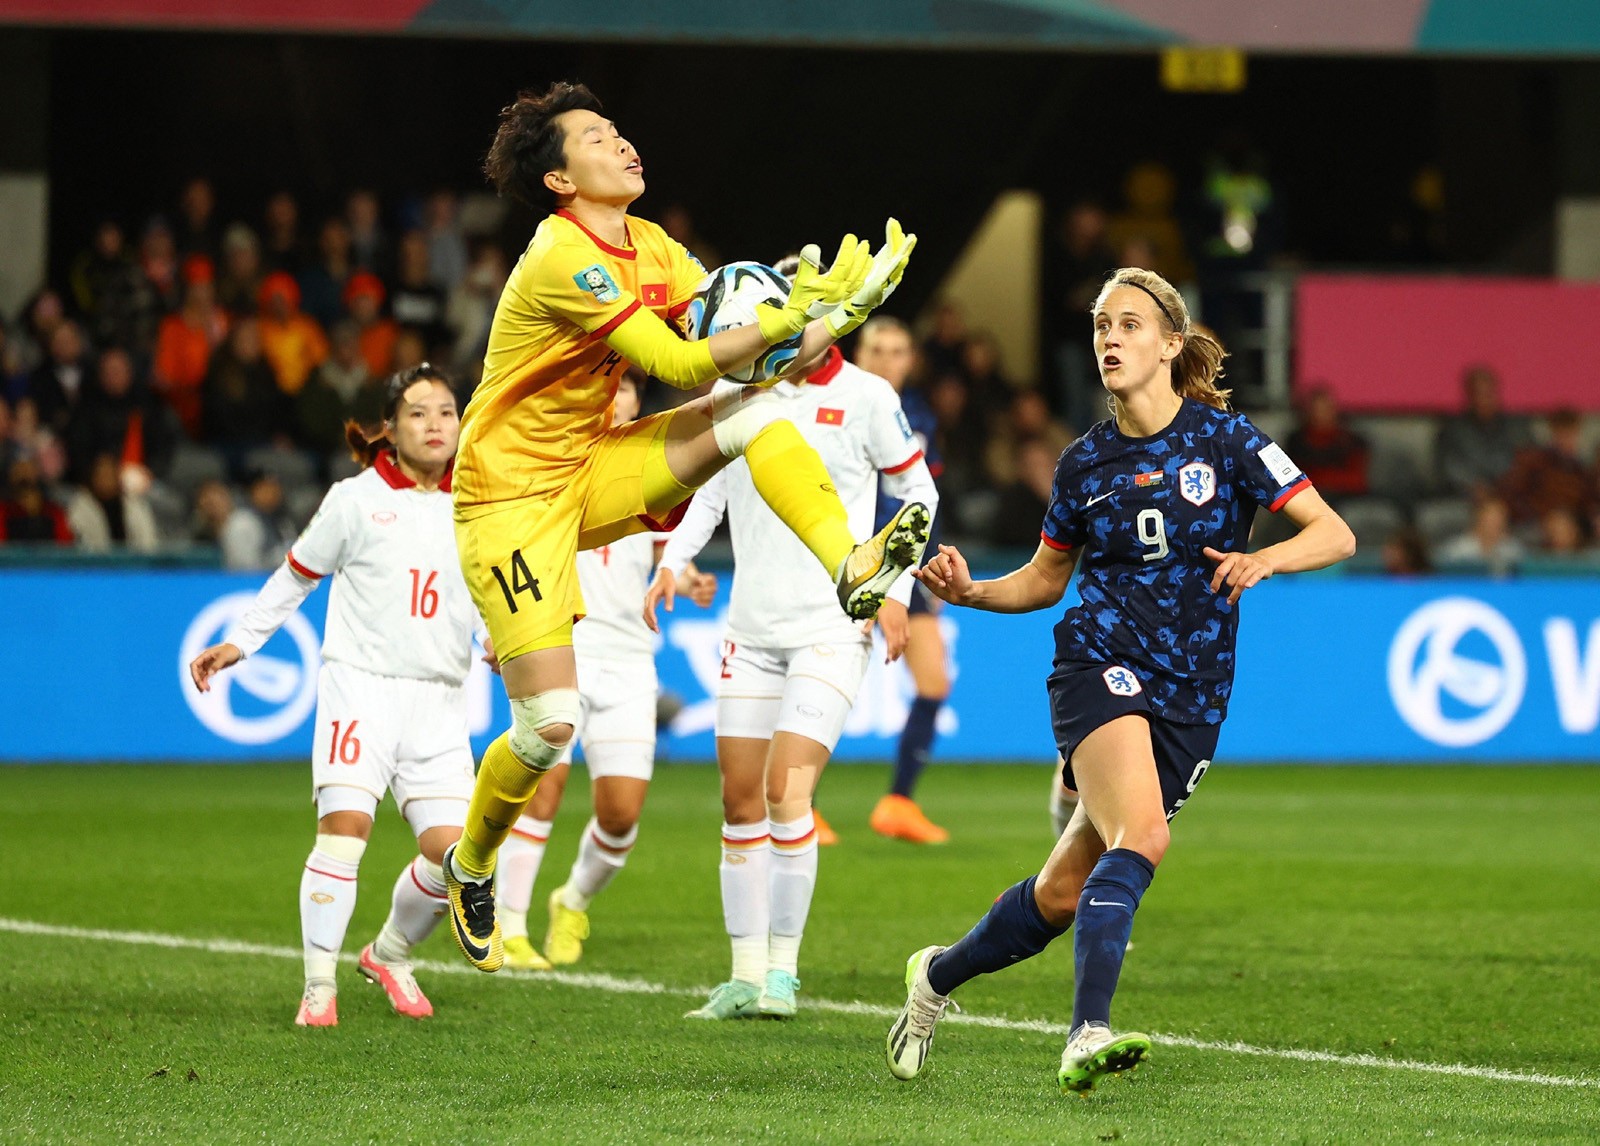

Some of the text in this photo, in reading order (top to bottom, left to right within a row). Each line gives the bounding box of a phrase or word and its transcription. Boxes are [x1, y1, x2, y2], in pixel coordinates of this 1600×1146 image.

[1136, 508, 1170, 562] 9
[409, 568, 439, 620] 16
[491, 548, 543, 614] 14
[329, 719, 361, 765] 16
